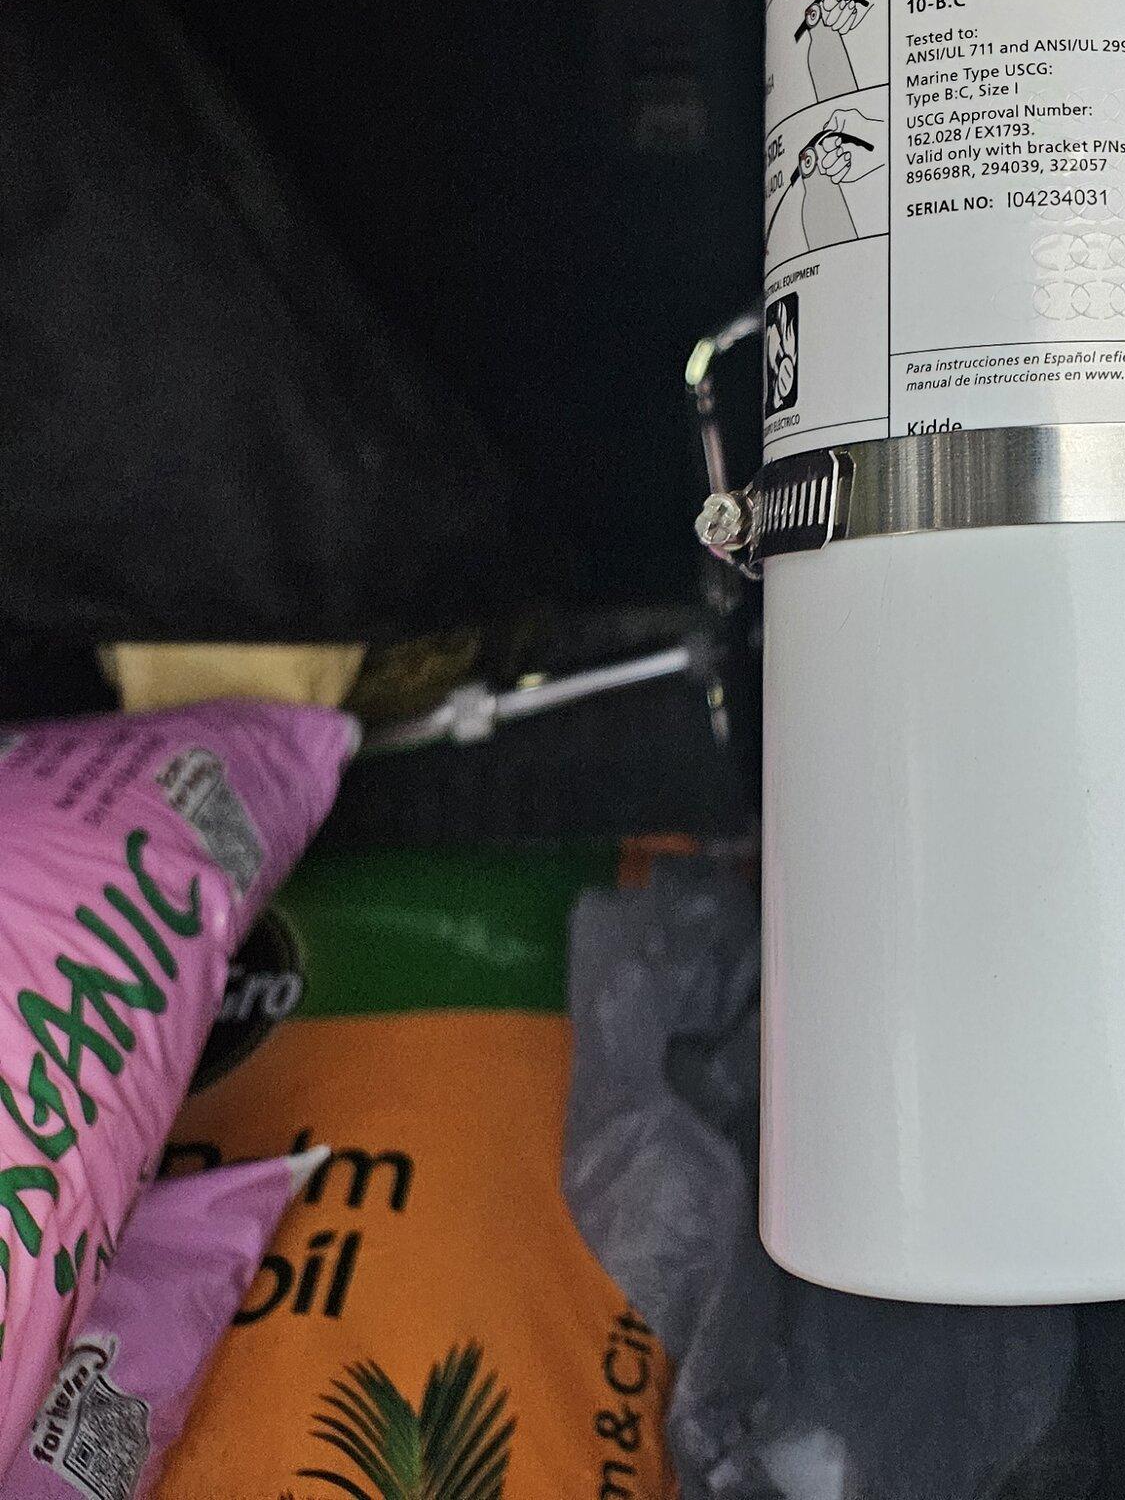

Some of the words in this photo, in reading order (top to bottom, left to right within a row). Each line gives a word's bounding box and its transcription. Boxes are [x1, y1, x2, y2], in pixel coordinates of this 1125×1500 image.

[905, 27, 954, 48] Tested
[957, 28, 979, 41] to:
[905, 45, 966, 66] ANSI/UL
[969, 41, 994, 57] 711
[999, 38, 1029, 55] and
[1033, 38, 1099, 53] ANSI/UL
[906, 70, 959, 89] Marine
[962, 66, 1000, 84] Type
[1004, 61, 1053, 77] USCG:
[905, 91, 940, 109] Type
[944, 85, 974, 101] B:C,
[978, 82, 1010, 98] Size
[906, 111, 945, 130] USCG
[948, 103, 1020, 126] Approval
[1023, 102, 1093, 118] Number:
[907, 127, 963, 148] 162.028
[974, 122, 1036, 140] EX1793.
[905, 147, 943, 166] Valid
[947, 144, 982, 162] only
[984, 140, 1022, 157] with
[1026, 138, 1089, 155] bracket
[905, 163, 976, 185] 896698R,
[980, 158, 1045, 177] 294039,
[1049, 157, 1108, 173] 322057
[906, 198, 960, 218] SERIAL
[963, 195, 994, 211] NO:
[905, 362, 933, 375] Para
[935, 355, 1020, 372] instrucciones
[1022, 355, 1040, 366] en
[1043, 350, 1097, 367] Español
[905, 374, 953, 392] manual
[954, 373, 971, 388] de
[973, 369, 1061, 386] instrucciones
[1063, 370, 1082, 382] en
[906, 417, 964, 437] Kidde
[0, 829, 201, 1295] GANIC
[32, 1420, 65, 1465] for
